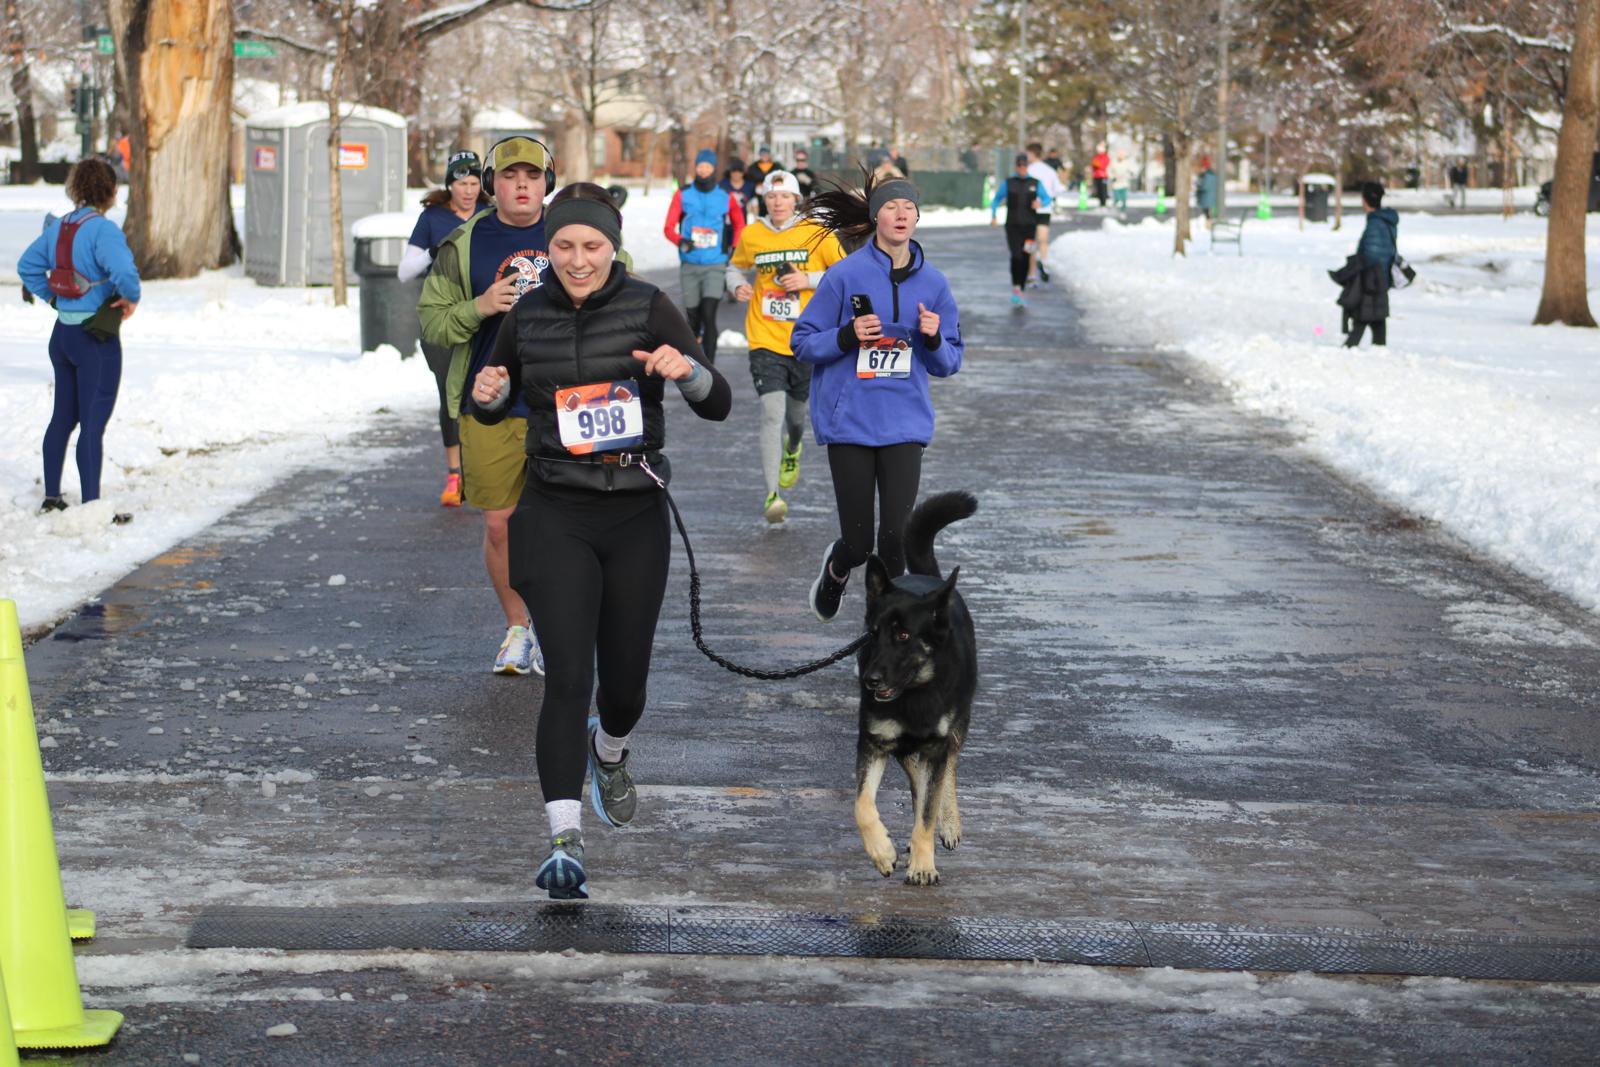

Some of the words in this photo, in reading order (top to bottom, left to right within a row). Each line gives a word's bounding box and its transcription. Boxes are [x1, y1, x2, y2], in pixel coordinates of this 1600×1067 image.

[755, 253, 784, 264] GREEN
[785, 251, 808, 261] BAY
[770, 301, 791, 316] 635
[869, 350, 900, 369] 677
[578, 405, 626, 439] 998
